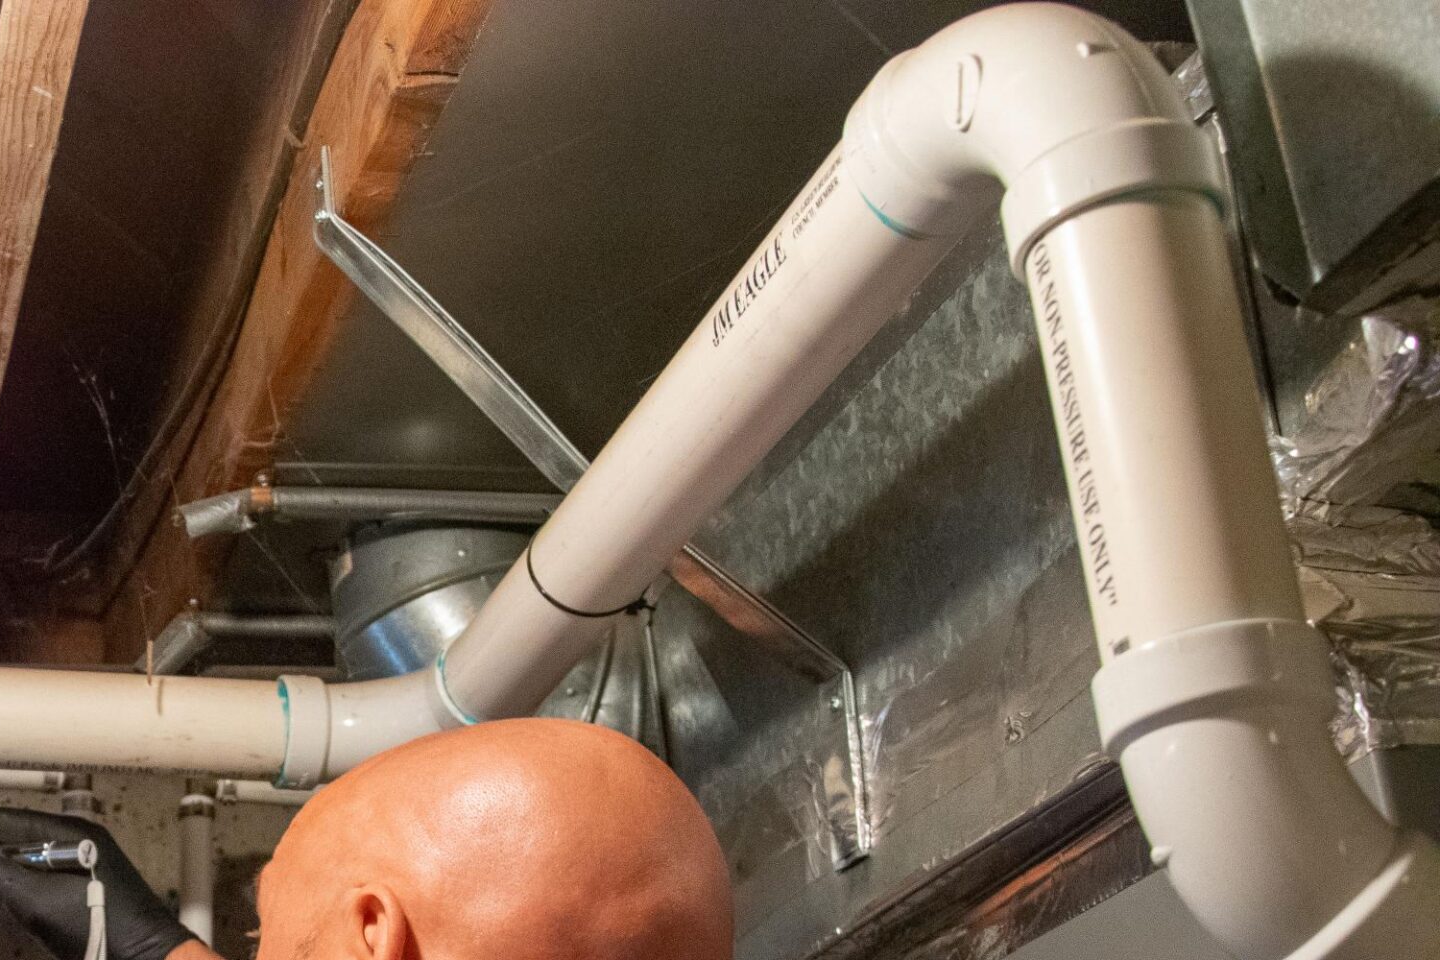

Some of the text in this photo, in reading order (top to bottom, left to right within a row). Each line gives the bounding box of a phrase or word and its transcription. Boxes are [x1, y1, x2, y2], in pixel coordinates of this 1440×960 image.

[733, 236, 788, 318] EAGLE
[1032, 242, 1051, 280] OR
[1042, 281, 1090, 465] NON-PRESSURE
[1077, 466, 1102, 526] USE
